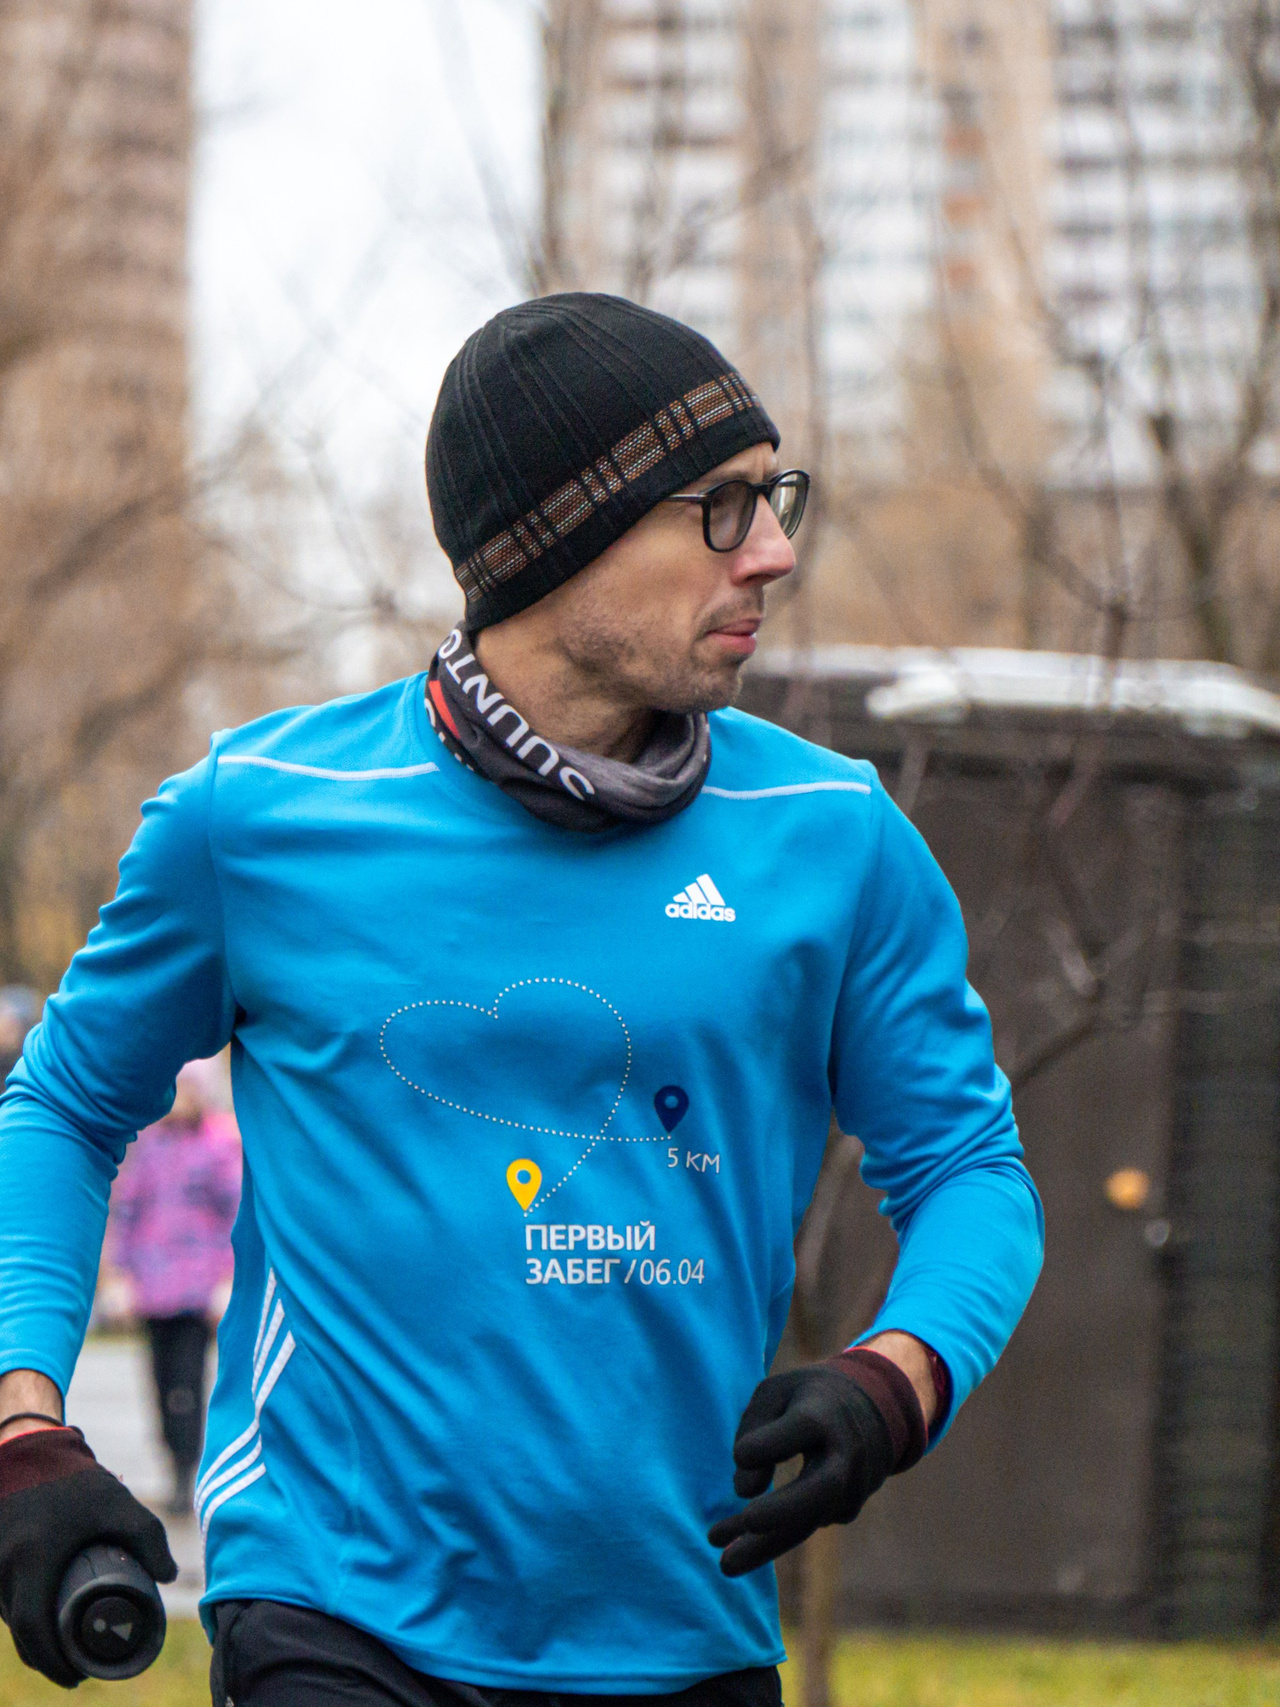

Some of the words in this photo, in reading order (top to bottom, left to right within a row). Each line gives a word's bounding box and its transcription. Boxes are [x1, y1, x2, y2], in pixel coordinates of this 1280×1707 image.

[664, 901, 736, 923] adidas
[667, 1147, 679, 1169] 5
[524, 1220, 656, 1251] ПЕРВЫЙ
[524, 1257, 621, 1285] ЗАБЕГ
